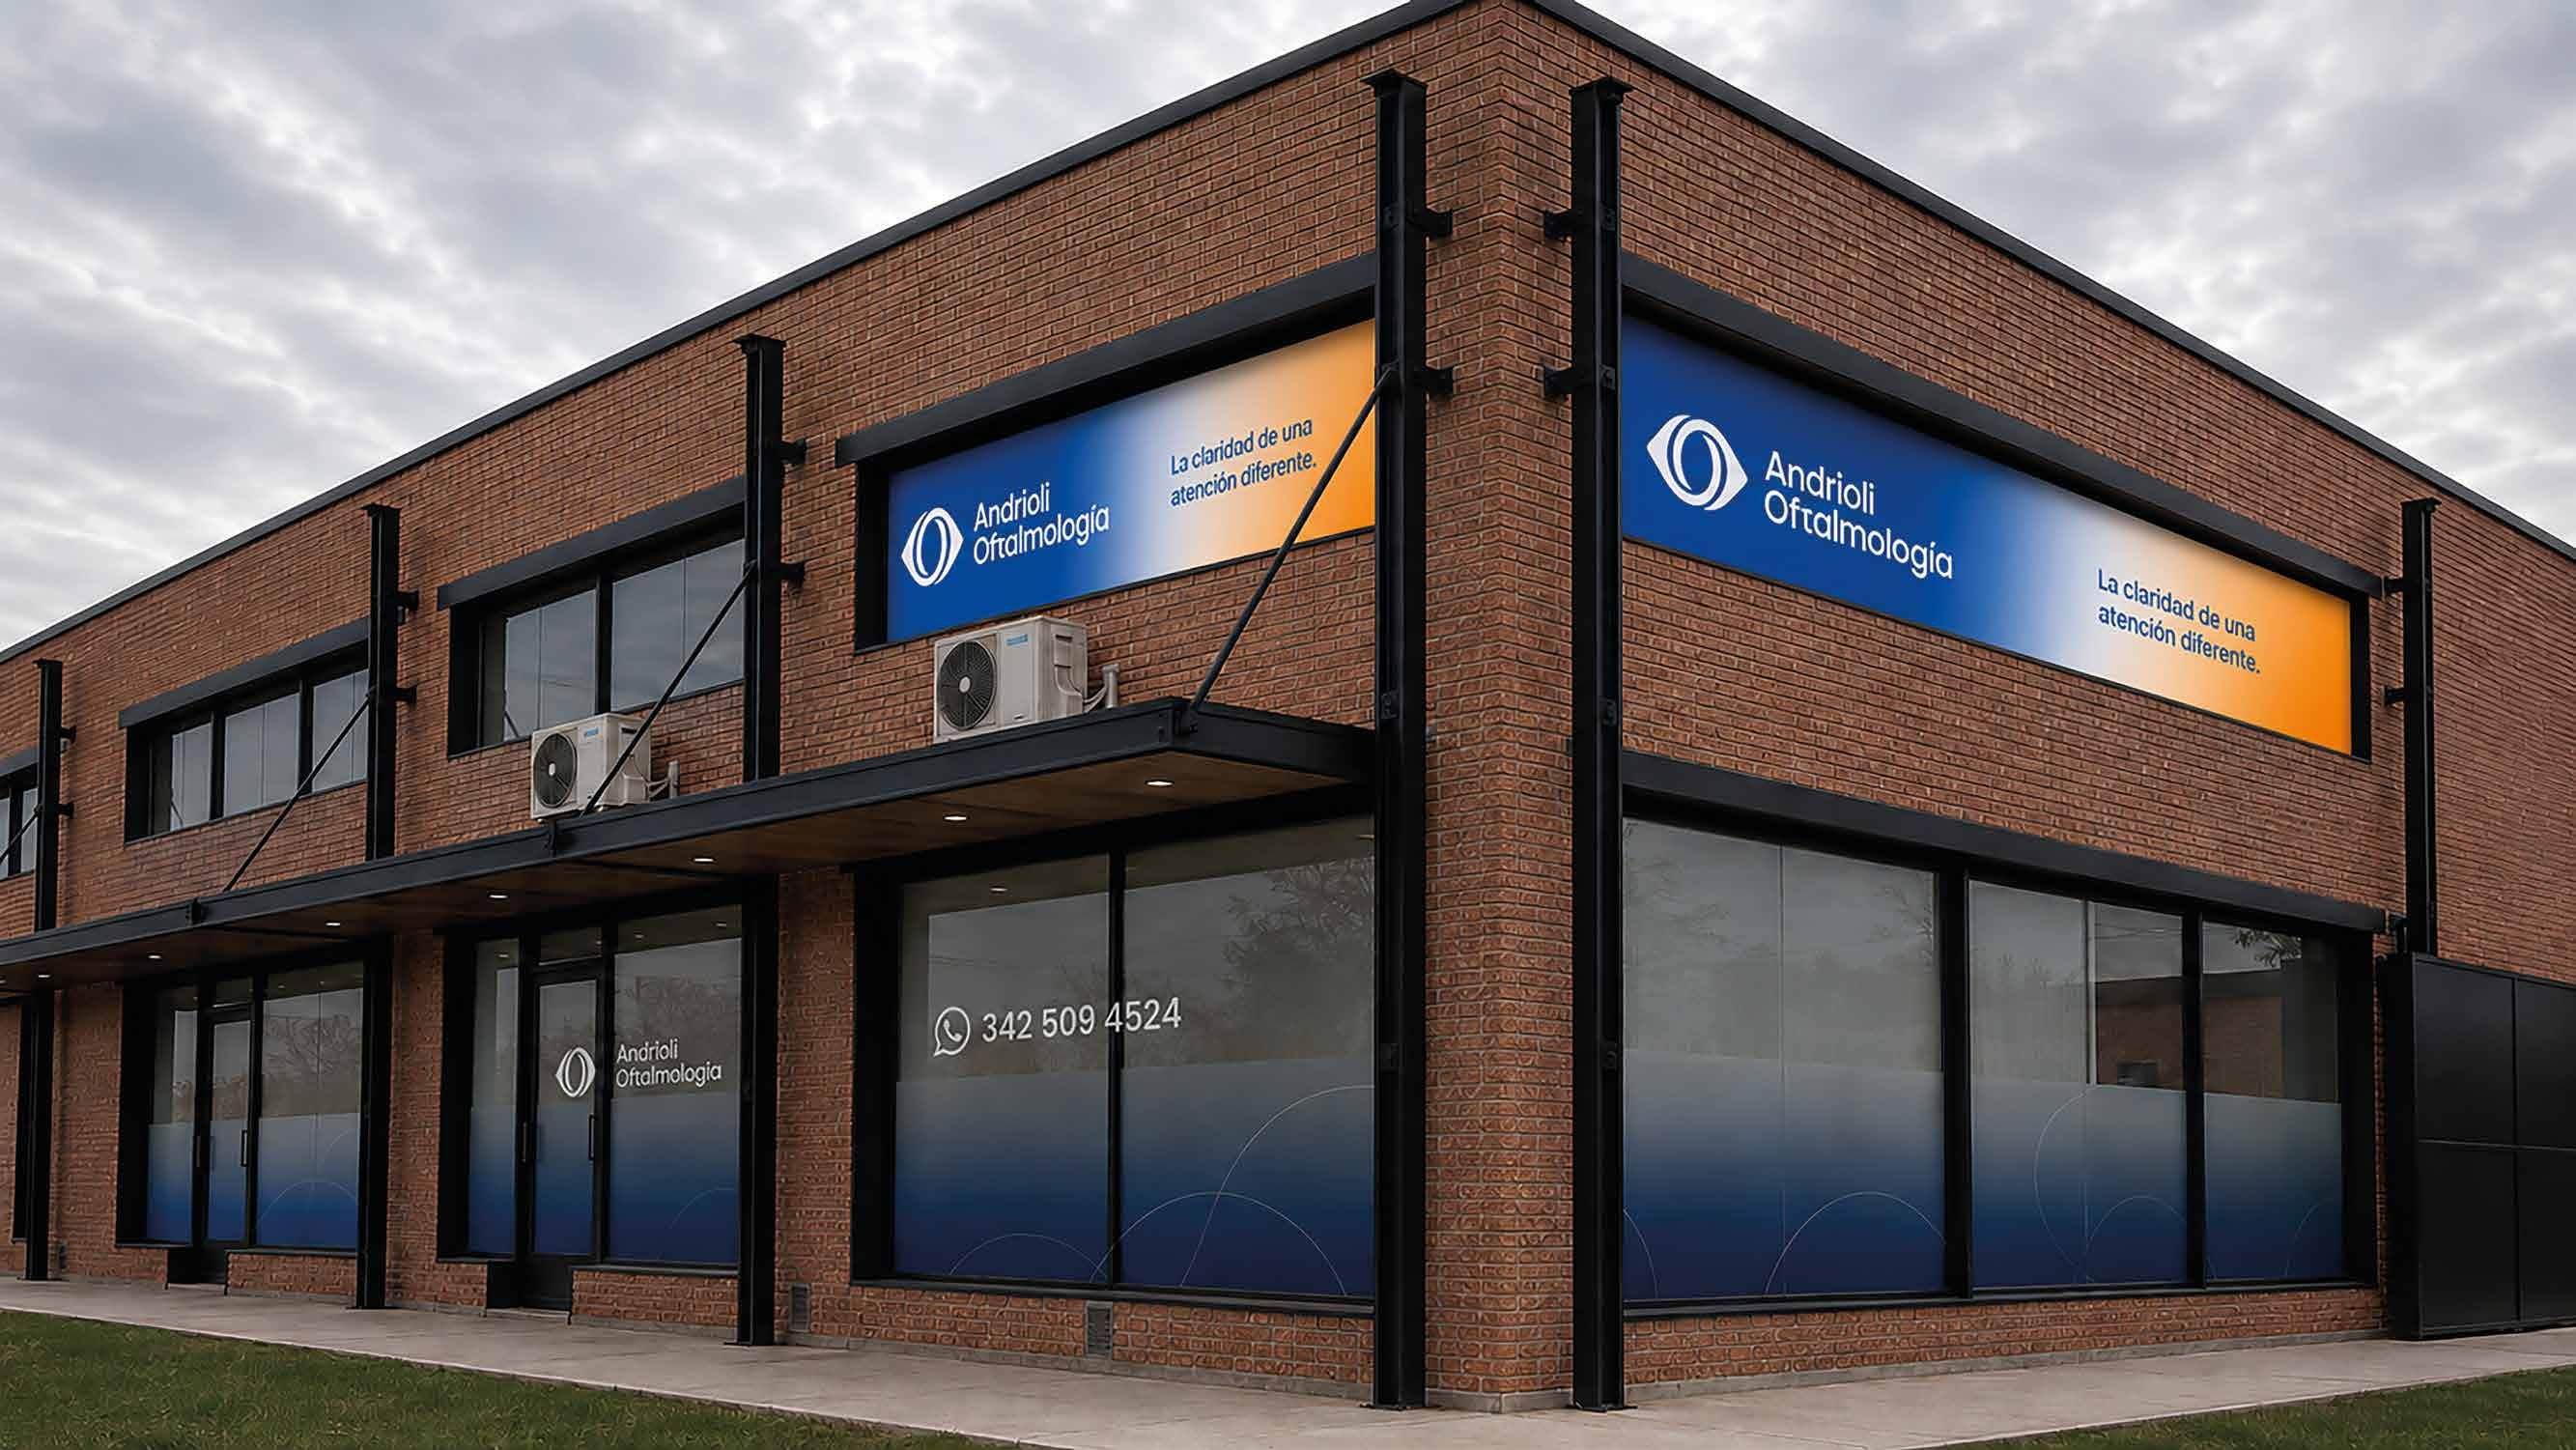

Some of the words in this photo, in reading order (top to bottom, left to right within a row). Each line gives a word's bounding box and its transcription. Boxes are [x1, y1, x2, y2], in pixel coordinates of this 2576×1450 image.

[1171, 453, 1188, 475] La
[1192, 434, 1255, 469] claridad
[1258, 427, 1279, 450] de
[1283, 417, 1313, 441] una
[973, 482, 1050, 531] Andrioli
[1170, 471, 1237, 506] atención
[1241, 450, 1317, 487] diferente.
[1765, 450, 1875, 515] Andrioli
[973, 503, 1110, 565] Oftalmología
[1764, 489, 1953, 580] Oftalmología
[2098, 569, 2119, 594] La
[2123, 580, 2194, 620] claridad
[2198, 605, 2221, 629] de
[2224, 617, 2255, 642] una
[2098, 604, 2176, 647] atención
[2180, 631, 2261, 674] diferente.
[981, 1010, 1033, 1042] 342
[1042, 1004, 1095, 1038] 509
[1104, 996, 1182, 1033] 4524
[616, 1038, 678, 1064] Andrioli
